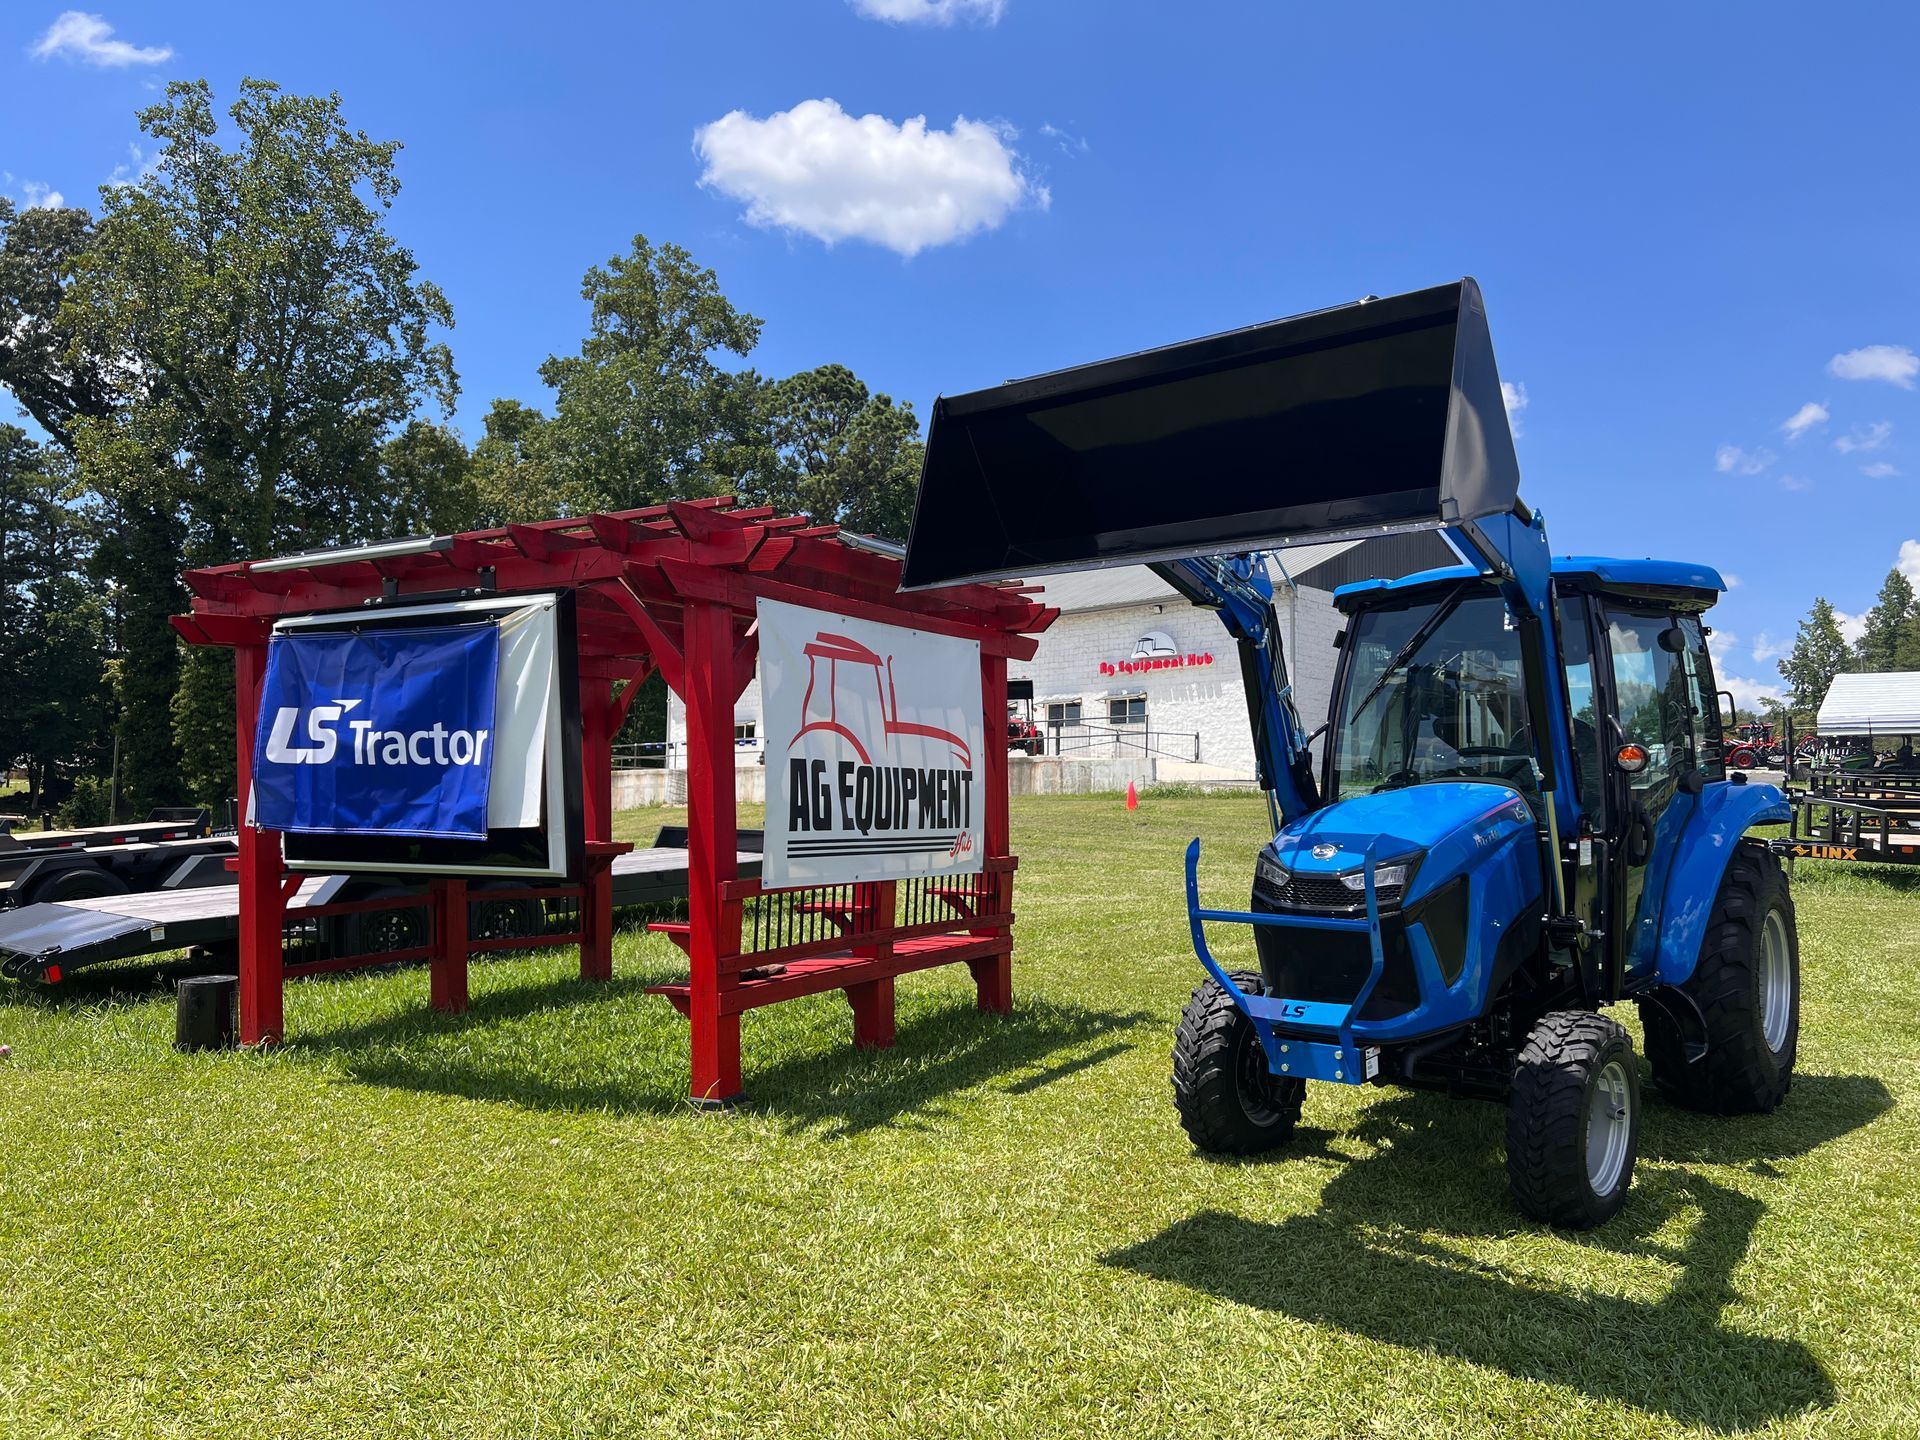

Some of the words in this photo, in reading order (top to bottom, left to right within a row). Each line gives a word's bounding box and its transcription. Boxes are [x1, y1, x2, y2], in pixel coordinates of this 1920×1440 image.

[1099, 661, 1115, 677] Ag
[1118, 655, 1184, 675] Equipment
[1187, 652, 1214, 667] Hub
[266, 705, 343, 764] LS
[349, 720, 488, 766] Tractor
[788, 758, 833, 832] AG
[838, 760, 973, 836] EQUIPMENT
[949, 831, 972, 858] Hub
[1811, 845, 1858, 861] LINX
[1280, 1004, 1306, 1019] LS
